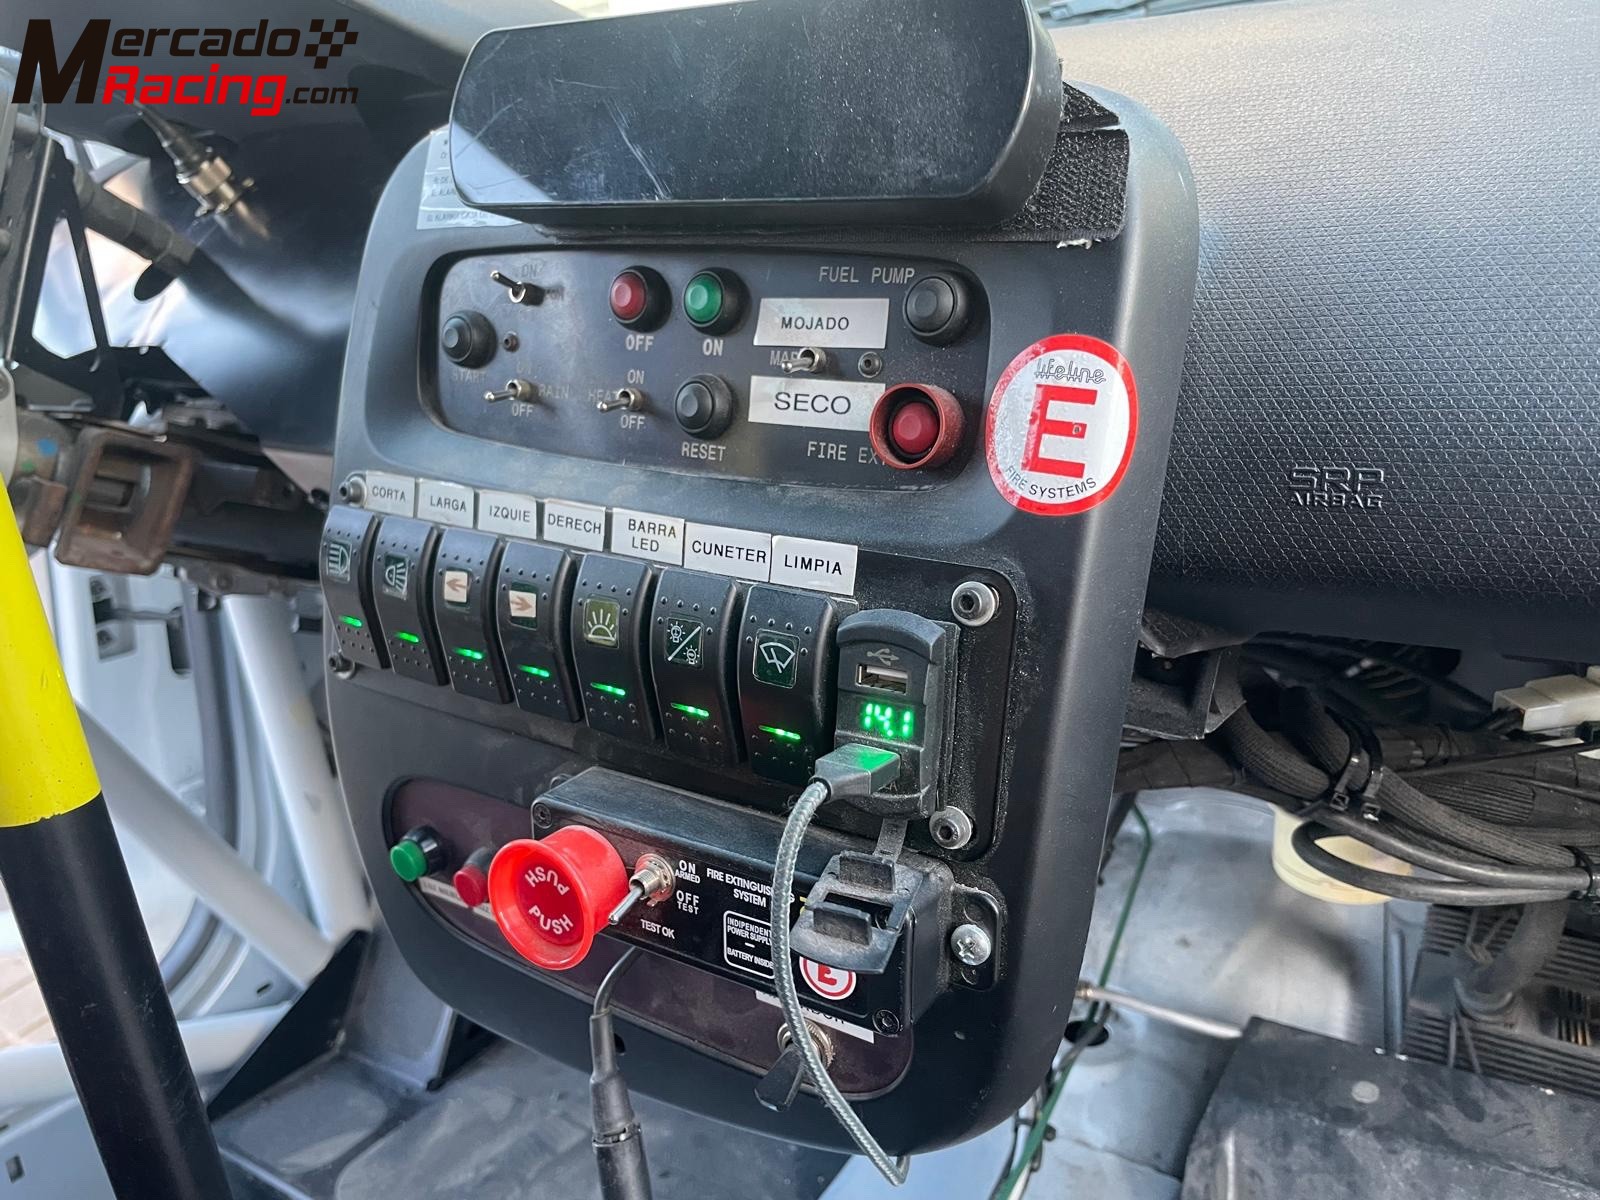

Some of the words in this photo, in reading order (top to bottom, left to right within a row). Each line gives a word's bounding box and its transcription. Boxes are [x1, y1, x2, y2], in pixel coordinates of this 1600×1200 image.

[819, 266, 859, 283] FUEL
[871, 267, 915, 285] PUMP
[781, 316, 850, 331] MOJADO
[625, 335, 654, 351] OFF
[703, 339, 723, 356] ON
[627, 369, 645, 384] ON
[511, 404, 534, 418] OFF
[774, 391, 851, 415] SECO
[620, 414, 646, 430] OFF
[1021, 383, 1098, 479] E
[681, 441, 726, 462] RESET
[807, 441, 847, 461] FIRE
[858, 447, 885, 466] EX
[1006, 465, 1028, 490] FIRE
[1028, 477, 1098, 499] SYSTEMS
[1289, 466, 1385, 491] SRP
[371, 486, 407, 503] CORTA
[429, 495, 468, 513] LARGA
[489, 505, 532, 523] IZQUIE
[547, 513, 602, 535] DERECH
[627, 518, 677, 539] BARRA
[631, 538, 660, 553] LED
[691, 540, 767, 564] CUNETER
[784, 554, 843, 576] LIMPIA
[679, 859, 696, 874] ON
[706, 867, 725, 882] FIRE
[524, 866, 570, 897] PUSH
[675, 869, 701, 884] ARMED
[676, 890, 700, 906] OFF
[733, 888, 767, 908] SYSTEM
[676, 900, 700, 916] TEST
[529, 904, 574, 936] PUSH
[640, 918, 662, 936] TEST
[661, 925, 676, 940] OK
[727, 925, 750, 940] POWER
[727, 946, 754, 963] BATTERY
[753, 955, 775, 970] INSIDE
